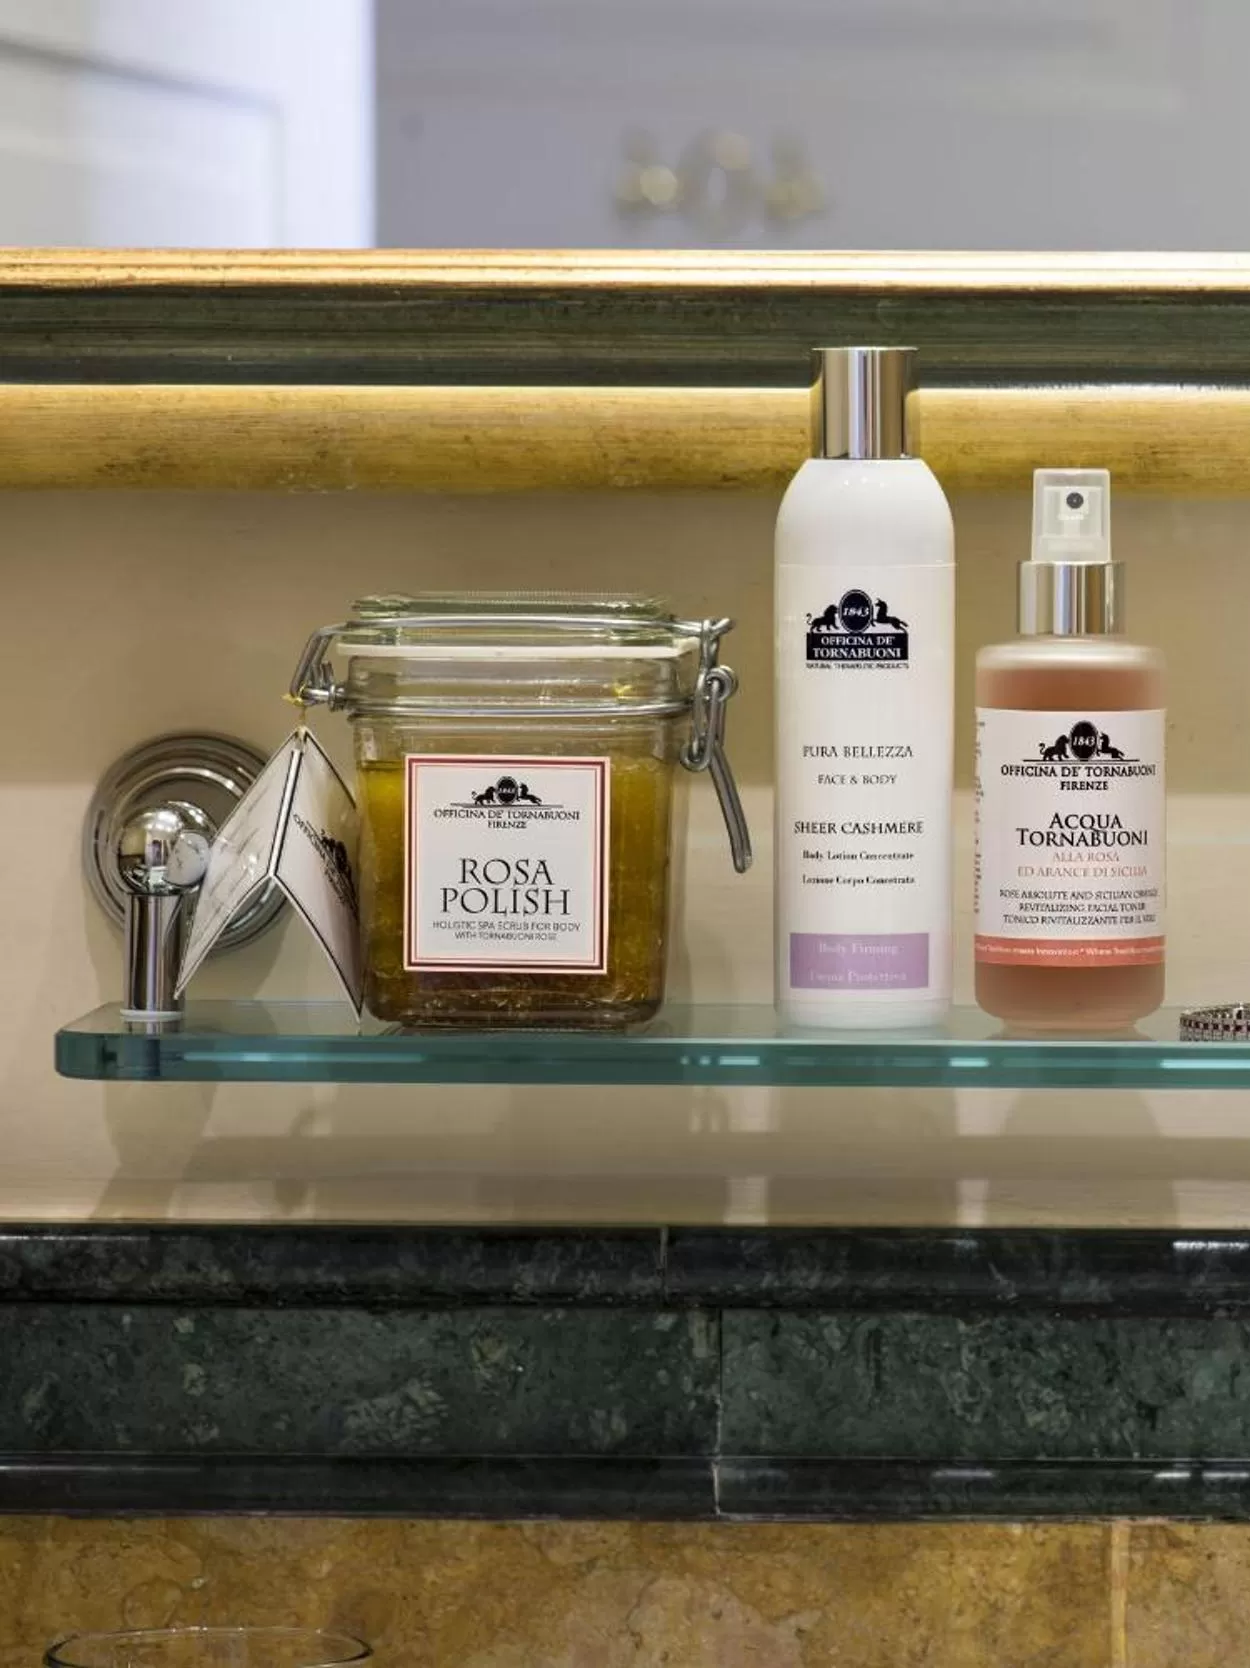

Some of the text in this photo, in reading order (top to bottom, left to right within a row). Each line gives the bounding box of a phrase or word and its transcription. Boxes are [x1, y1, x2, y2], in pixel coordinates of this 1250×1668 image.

[820, 636, 873, 646] OFFICINA
[812, 647, 902, 659] TORNABUONI
[1072, 736, 1095, 747] 1843
[802, 746, 913, 758] PURA BELLEZZA
[1001, 764, 1057, 777] OFFICINA
[1085, 764, 1156, 777] TORNABUONI
[817, 774, 898, 785] FACE & BODY
[1060, 781, 1109, 791] FIRENZE
[433, 809, 487, 819] OFFICINA
[507, 810, 580, 820] TORNABUONI
[487, 821, 527, 829] FIRENZE
[1049, 812, 1123, 832] ACQUA
[793, 821, 924, 835] SHEER CASHMERE
[1016, 828, 1148, 847] TORNABUONI
[828, 851, 857, 861] Lotion
[1052, 853, 1120, 862] ALLA ROSA
[459, 858, 555, 885] ROSA
[1017, 867, 1034, 877] ED
[1038, 867, 1089, 877] ARANCE
[1093, 867, 1108, 877] DI
[1070, 890, 1094, 900] AND
[440, 888, 571, 916] POLISH
[433, 921, 581, 932] HOLISTIC SPA SCRUB FOR BODY
[455, 932, 476, 940] WITH
